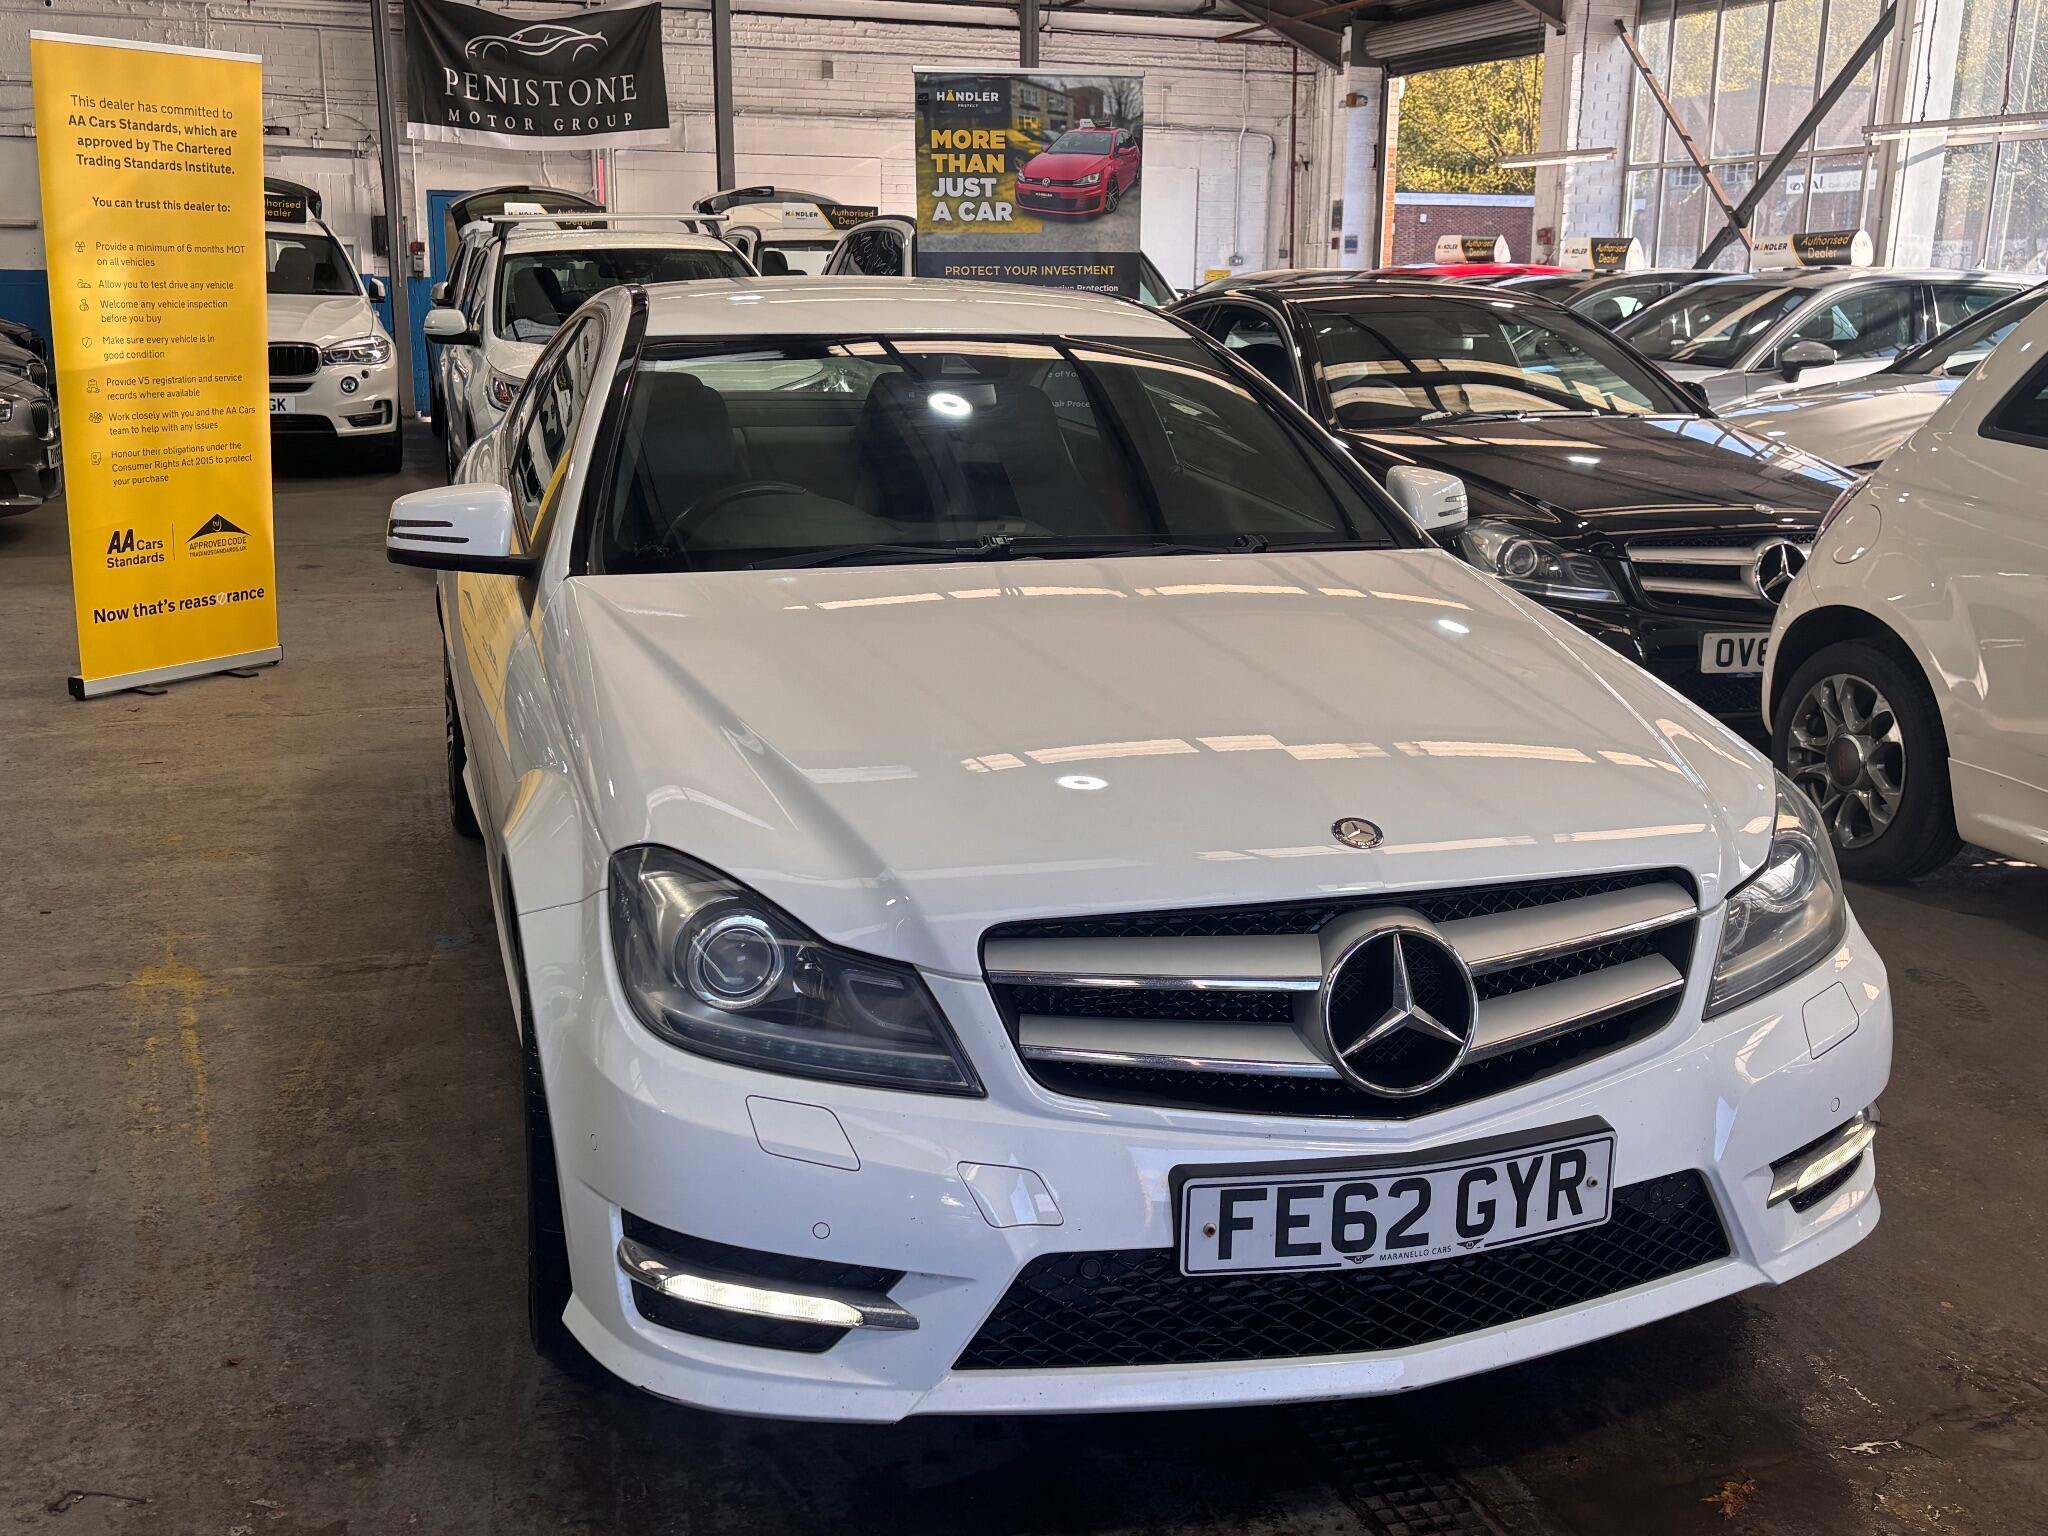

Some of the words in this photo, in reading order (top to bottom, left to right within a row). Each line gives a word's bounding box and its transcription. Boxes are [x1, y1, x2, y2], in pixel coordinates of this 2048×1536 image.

[443, 67, 637, 106] PENISTONE
[70, 95, 96, 108] This
[99, 98, 135, 111] dealer
[138, 101, 157, 112] has
[161, 104, 219, 118] committed
[222, 108, 233, 119] to
[69, 115, 86, 126] AA
[89, 117, 116, 128] Cars
[119, 119, 181, 135] Standards,
[184, 125, 217, 136] which
[220, 128, 237, 138] are
[449, 108, 533, 130] MOTOR
[554, 112, 632, 131] GROUP
[77, 136, 132, 149] approved
[137, 139, 150, 152] by
[152, 140, 173, 151] The
[176, 142, 231, 155] Chartered
[931, 130, 1006, 149] MORE
[76, 154, 121, 169] Trading
[124, 157, 182, 171] Standards
[186, 161, 235, 174] Institute.
[931, 154, 1004, 173] THAN
[932, 178, 996, 197] JUST
[93, 197, 112, 207] You
[115, 200, 132, 208] can
[135, 199, 160, 209] trust
[163, 201, 181, 210] this
[184, 201, 215, 211] dealer
[218, 203, 230, 212] to:
[932, 202, 952, 221] A
[958, 201, 1012, 221] CAR
[265, 209, 291, 217] ealer
[831, 208, 874, 217] Authorised
[839, 217, 860, 225] Deal
[1801, 234, 1850, 246] Authorised
[96, 242, 126, 251] Provide
[137, 244, 174, 252] minimum
[177, 244, 186, 252] of
[187, 244, 192, 252] 6
[195, 245, 224, 253] months
[226, 245, 245, 253] MOT
[1808, 247, 1837, 258] Dealer
[121, 258, 155, 267] vehicles
[1599, 254, 1618, 263] Dealer
[945, 266, 1000, 276] PROTECT
[1004, 266, 1038, 276] YOUR
[1041, 265, 1115, 276] INVESTMENT
[99, 280, 121, 288] Allow
[124, 282, 138, 290] you
[169, 280, 188, 289] drive
[190, 282, 204, 290] any
[206, 281, 233, 289] vehicle
[101, 300, 138, 308] Welcome
[141, 302, 155, 310] any
[158, 300, 185, 308] vehicle
[188, 300, 228, 309] inspection
[101, 314, 127, 322] before
[130, 316, 144, 324] you
[147, 314, 161, 323] buy
[103, 336, 124, 345] Make
[147, 337, 168, 345] every
[171, 335, 197, 343] vehicle
[200, 334, 206, 342] is
[208, 334, 215, 342] in
[104, 352, 124, 361] good
[127, 350, 165, 359] condition
[107, 378, 136, 386] Provide
[139, 377, 150, 385] V5
[152, 375, 196, 385] registration
[215, 374, 242, 382] service
[108, 392, 137, 400] records
[139, 390, 164, 398] where
[167, 388, 200, 398] available
[109, 412, 130, 421] Work
[132, 412, 160, 421] closely
[181, 410, 194, 418] you
[196, 408, 210, 416] and
[226, 406, 237, 415] AA
[239, 405, 255, 414] Cars
[110, 426, 129, 435] team
[131, 425, 139, 434] to
[142, 424, 159, 433] help
[161, 423, 178, 432] with
[180, 423, 193, 431] any
[195, 421, 218, 429] issues
[112, 449, 140, 458] Honour
[142, 448, 161, 456] their
[163, 445, 204, 456] obligations
[206, 443, 227, 452] under
[112, 462, 152, 472] Consumer
[155, 459, 179, 469] Rights
[181, 458, 193, 466] Act
[196, 456, 213, 465] 2015
[225, 454, 252, 463] protect
[113, 478, 130, 487] your
[132, 474, 169, 484] purchase
[107, 529, 134, 554] AA
[137, 539, 163, 551] Cars
[190, 539, 226, 550] APPROVED
[228, 537, 246, 545] CODE
[107, 552, 164, 568] Standards
[94, 608, 129, 624] Now
[133, 599, 175, 617] that’s
[1218, 1176, 1431, 1260] FE62
[1455, 1148, 1587, 1239] GYR
[1380, 1250, 1429, 1261] MARANELLO
[1432, 1246, 1451, 1255] CARS
